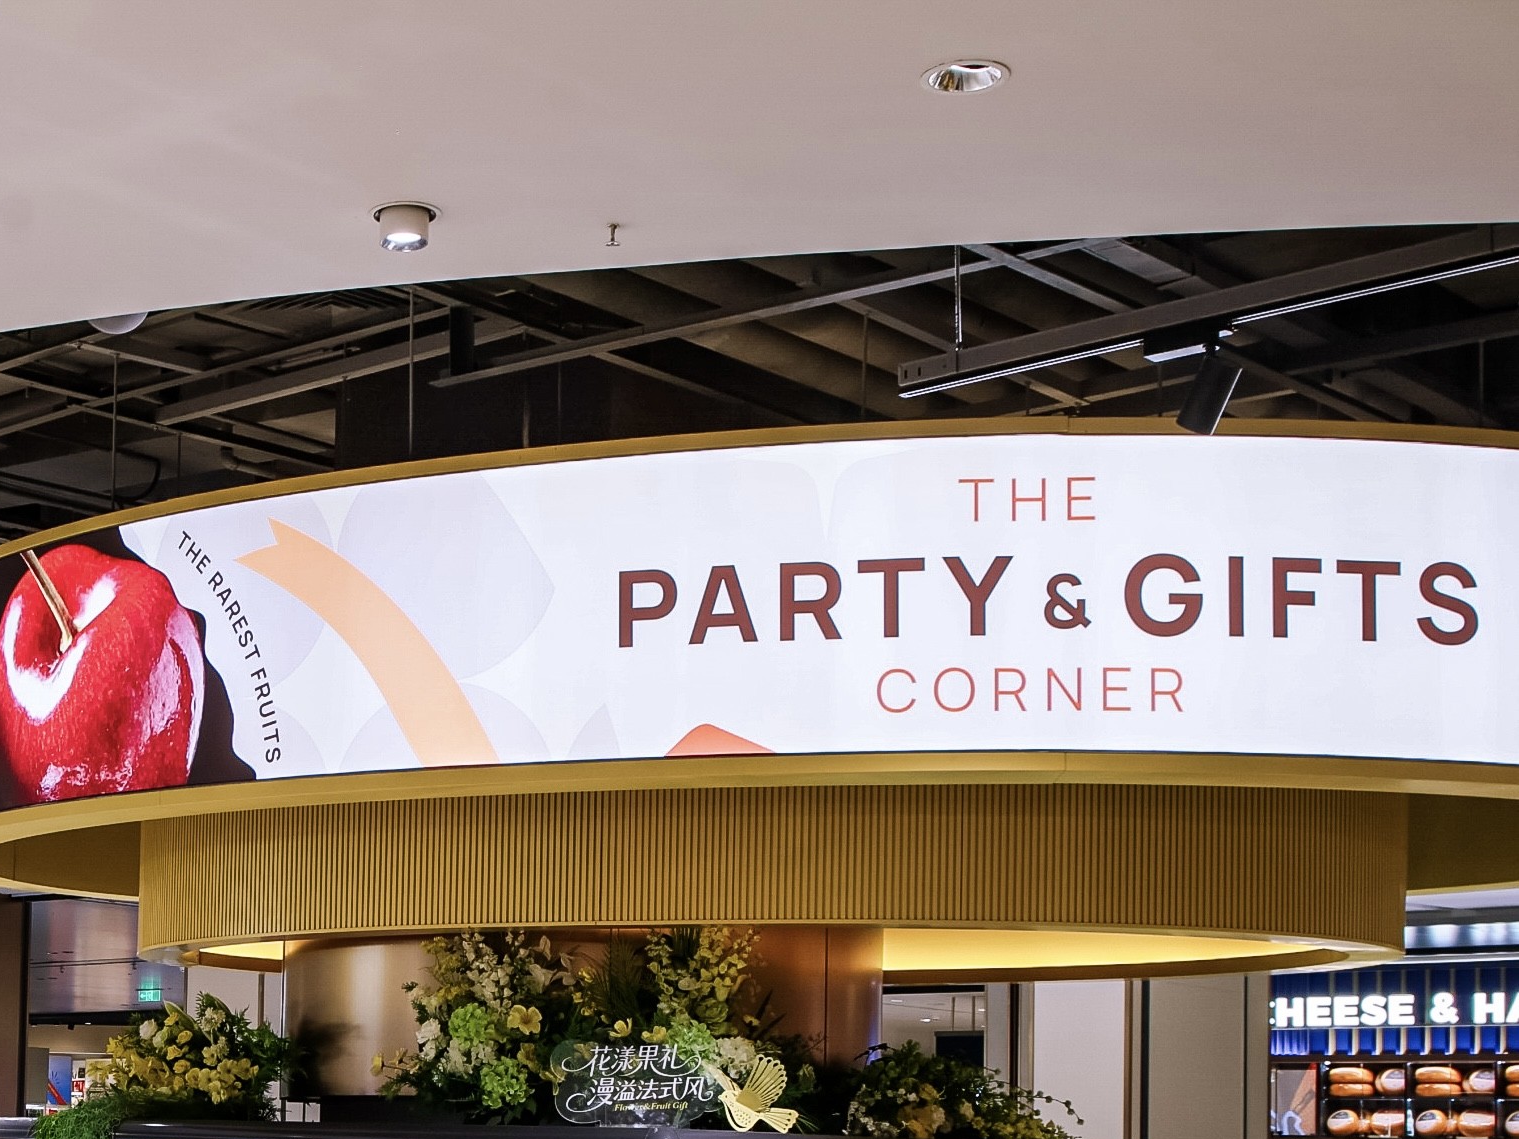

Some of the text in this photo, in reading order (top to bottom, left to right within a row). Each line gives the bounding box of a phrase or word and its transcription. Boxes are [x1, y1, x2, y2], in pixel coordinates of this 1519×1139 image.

[958, 475, 1098, 522] THE
[618, 552, 1480, 648] PARTY & GIFTS
[178, 530, 281, 764] THE RAREST FRUITS
[876, 667, 1185, 714] CORNER
[1269, 994, 1416, 1028] HEESE
[1429, 991, 1459, 1024] &
[562, 1043, 702, 1078] 花漾果礼
[566, 1076, 714, 1112] 漫溢法式风
